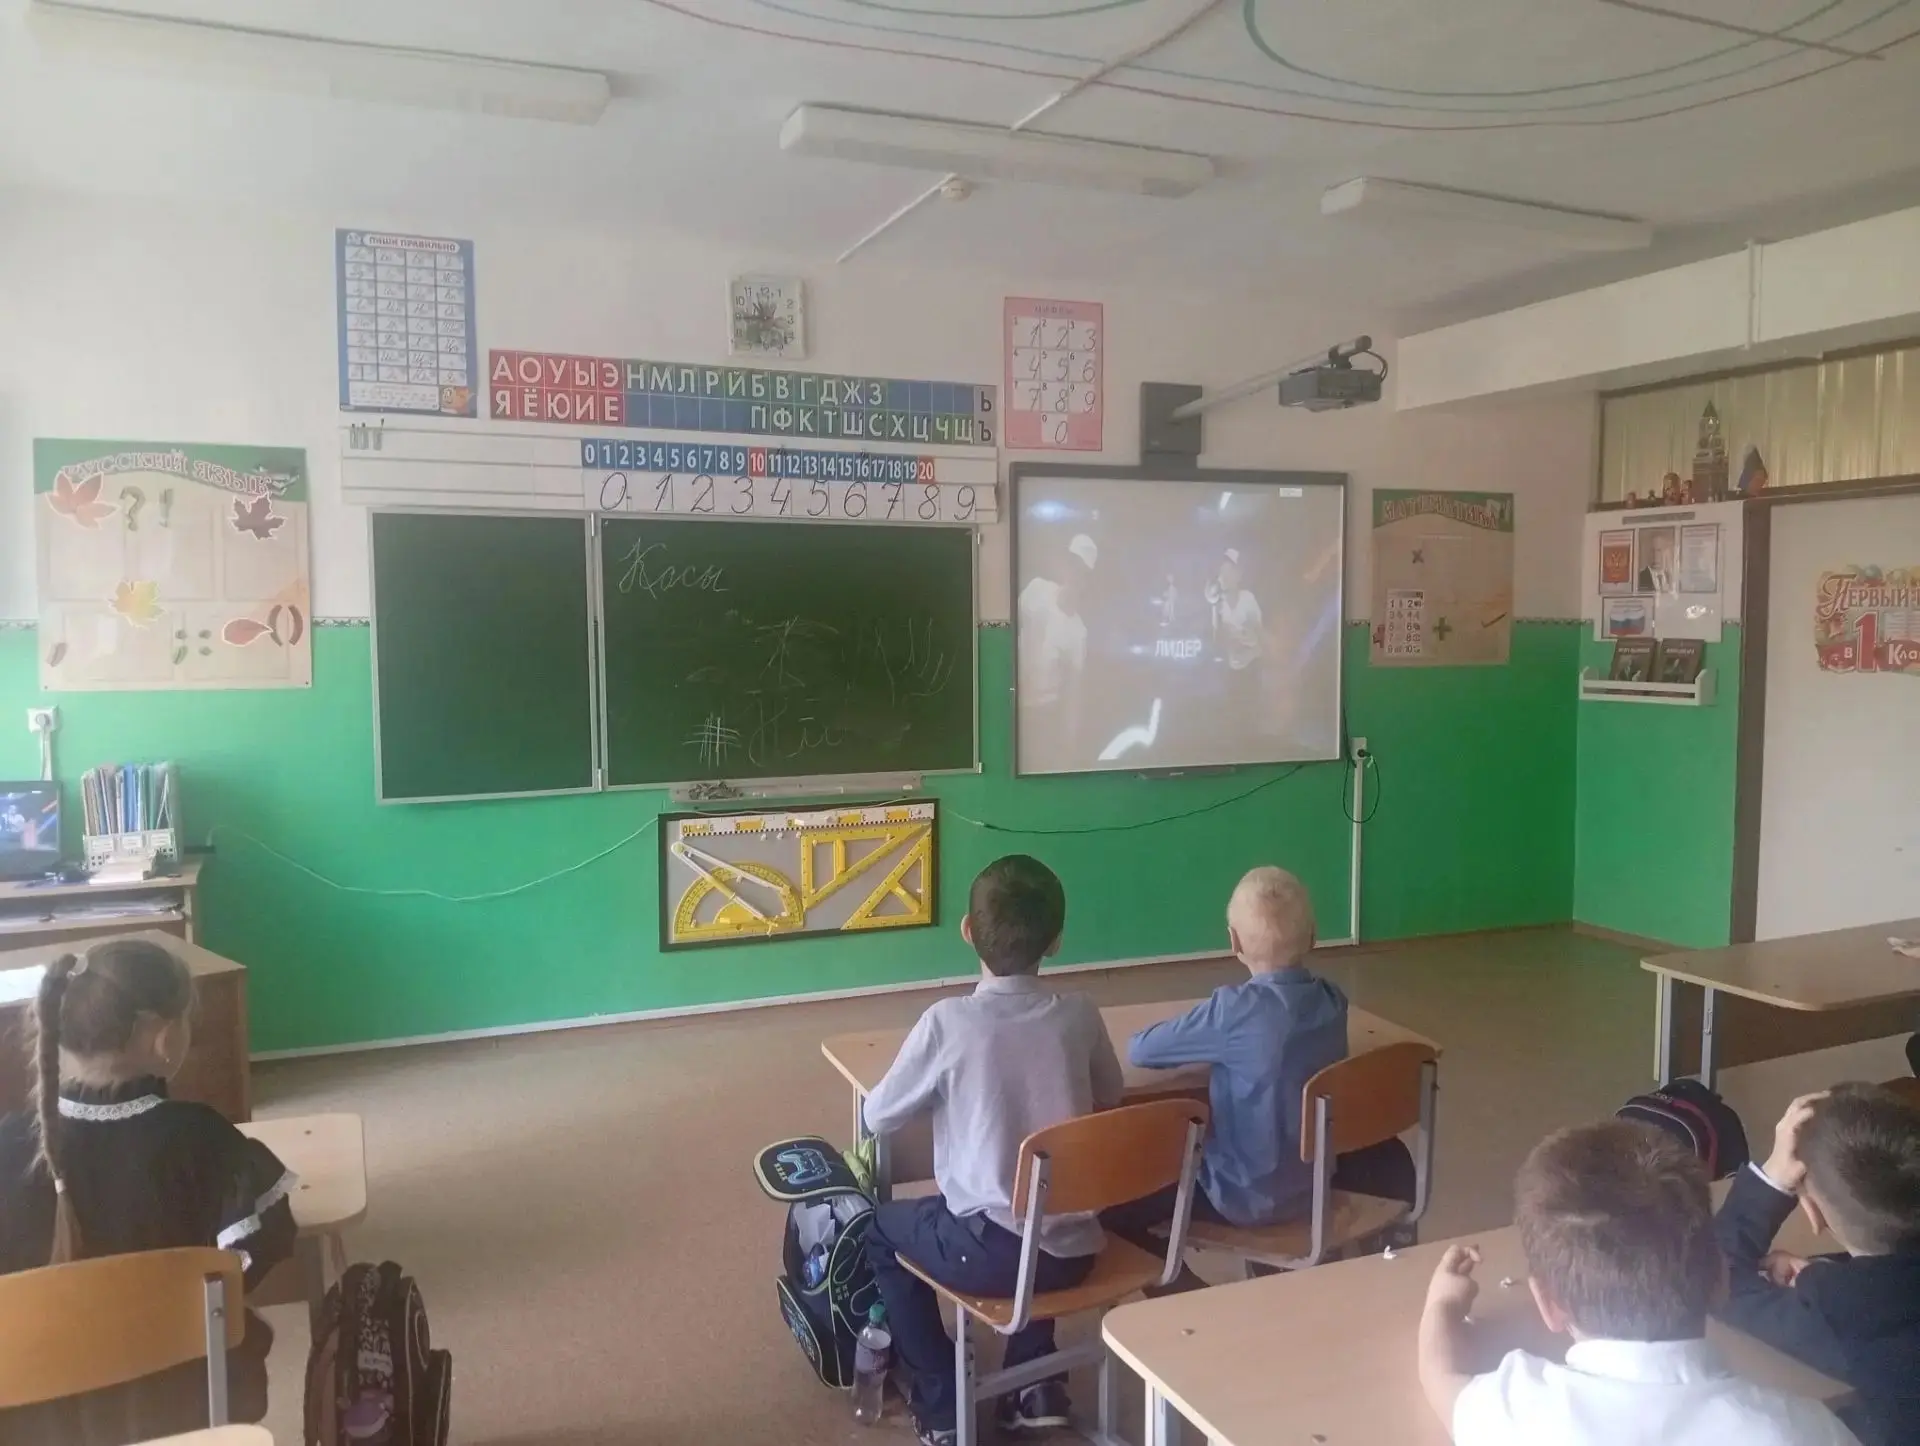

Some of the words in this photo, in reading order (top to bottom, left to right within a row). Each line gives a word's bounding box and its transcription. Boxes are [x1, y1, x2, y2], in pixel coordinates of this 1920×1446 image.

[1030, 324, 1039, 346] 1
[1083, 328, 1096, 351] 3
[492, 356, 514, 382] А
[519, 357, 542, 384] О
[548, 359, 566, 384] У
[574, 361, 596, 386] Ы
[602, 362, 619, 388] Э
[626, 364, 644, 390] Н
[650, 366, 673, 392] М
[677, 368, 696, 394] Л
[706, 370, 720, 394] Р
[752, 374, 766, 398] Б
[776, 376, 789, 400] В
[800, 377, 812, 400] Г
[820, 379, 838, 405] Д
[843, 381, 862, 404] Ж
[869, 383, 883, 406] З
[1029, 355, 1040, 380] 4
[1057, 357, 1068, 382] 5
[1082, 359, 1096, 383] 6
[496, 390, 511, 416] Я
[524, 388, 538, 417] Ё
[548, 392, 570, 418] Ю
[576, 395, 594, 420] И
[604, 396, 619, 422] Е
[752, 406, 766, 430] П
[773, 407, 792, 431] Ф
[800, 409, 814, 432] К
[824, 410, 838, 434] Т
[843, 412, 863, 436] Ш
[868, 414, 883, 437] С
[891, 415, 905, 438] Х
[914, 416, 929, 442] Ц
[936, 417, 949, 440] Ч
[954, 418, 974, 444] Щ
[1029, 387, 1041, 412] 7
[1056, 388, 1068, 412] 8
[1083, 390, 1096, 413] 9
[1055, 420, 1068, 444] 0
[584, 444, 595, 464] 0
[602, 445, 611, 464] 1
[619, 446, 630, 466] 2
[636, 447, 646, 466] 3
[653, 448, 664, 467] 4
[670, 448, 680, 468] 5
[686, 450, 697, 469] 6
[704, 450, 712, 470] 7
[719, 451, 730, 470] 8
[735, 452, 746, 471] 9
[750, 453, 764, 472] 10
[768, 454, 782, 473] 11
[786, 455, 800, 474] 12
[804, 456, 818, 475] 13
[821, 456, 836, 476] 14
[838, 458, 853, 477] 15
[855, 458, 870, 478] 16
[872, 460, 885, 479] 17
[888, 460, 902, 480] 18
[904, 461, 917, 480] 19
[920, 462, 934, 480] 20
[600, 472, 628, 510] 0
[655, 473, 673, 512] 1
[690, 474, 714, 512] 2
[731, 476, 754, 514] 3
[770, 477, 791, 515] 4
[807, 479, 828, 516] 5
[844, 481, 867, 518] 6
[882, 482, 902, 519] 7
[918, 484, 940, 520] 8
[954, 485, 976, 521] 9
[1154, 639, 1202, 660] ЛИДЕР
[1855, 611, 1878, 672] 1
